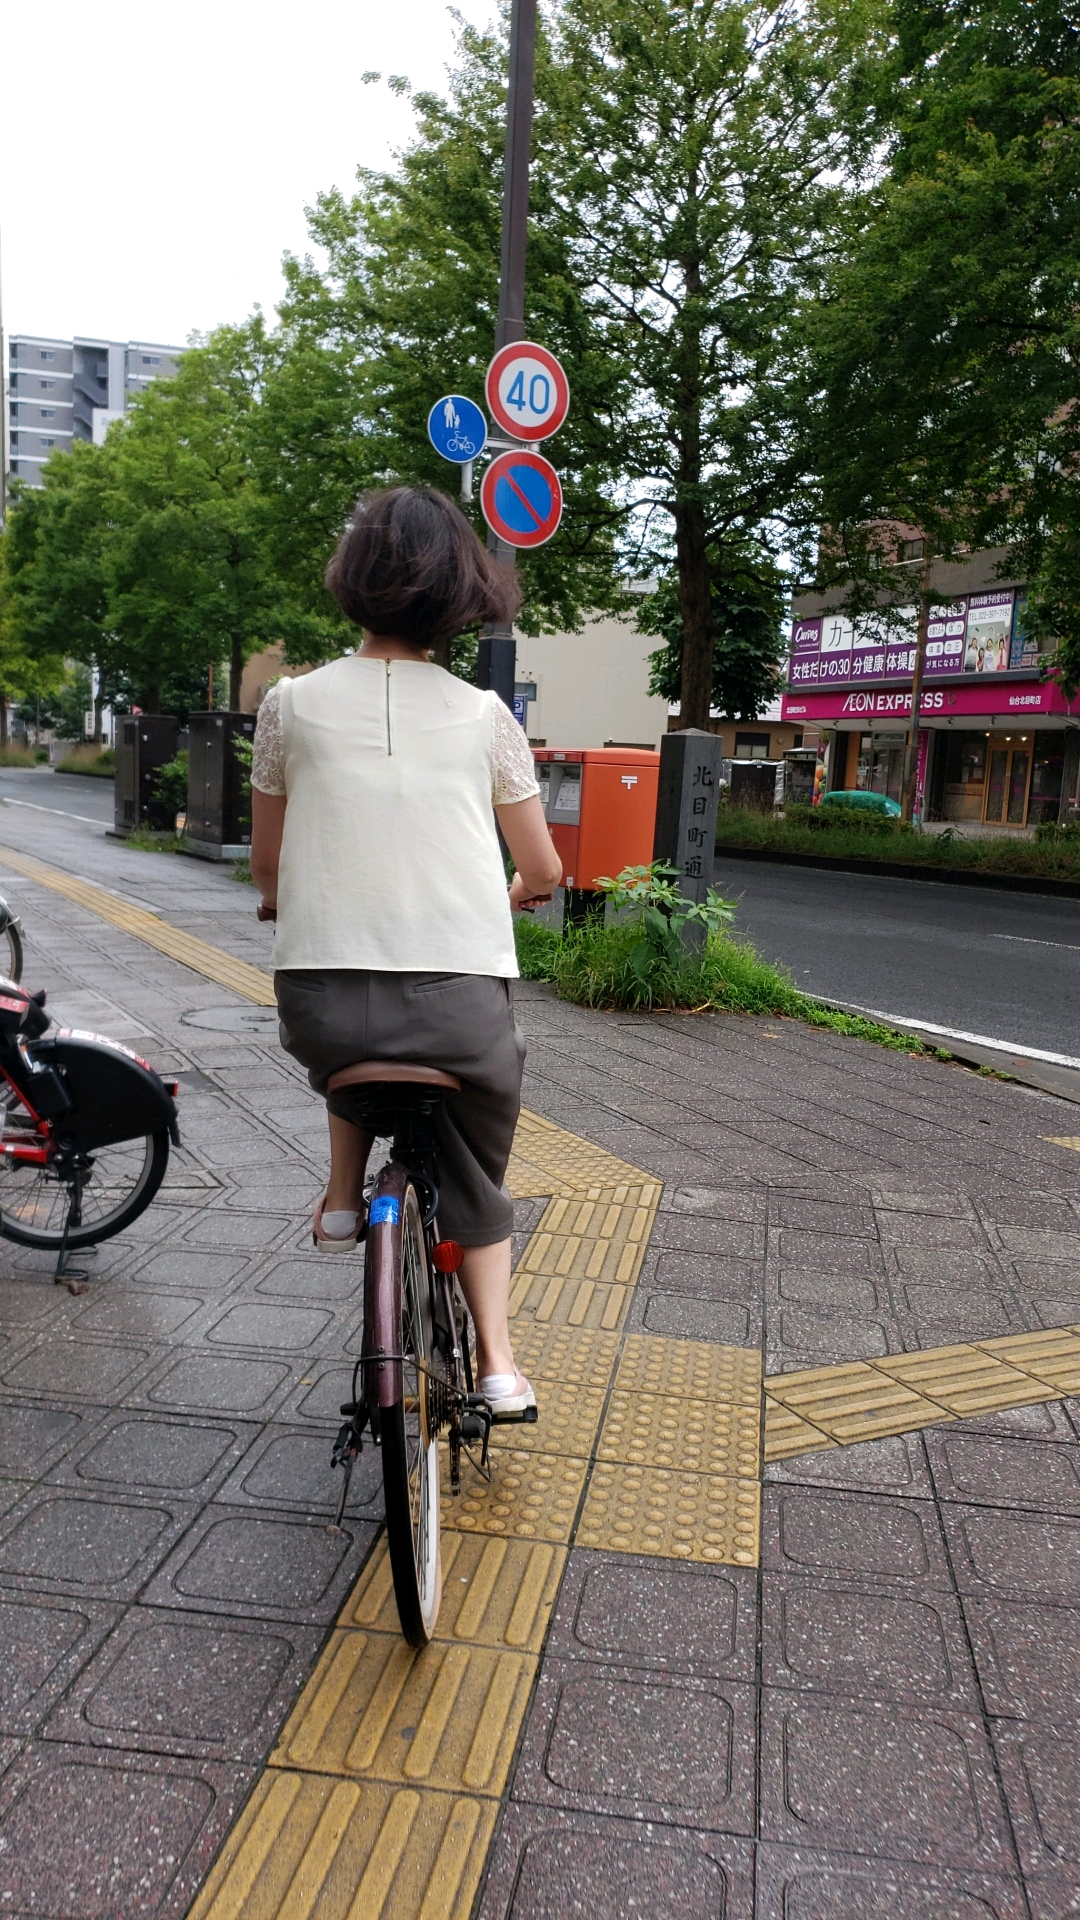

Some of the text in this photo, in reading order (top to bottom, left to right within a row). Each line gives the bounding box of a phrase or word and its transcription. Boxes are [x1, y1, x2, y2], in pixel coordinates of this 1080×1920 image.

[506, 370, 550, 414] 40
[926, 658, 960, 669] が気になる方
[684, 765, 713, 879] 北目町通
